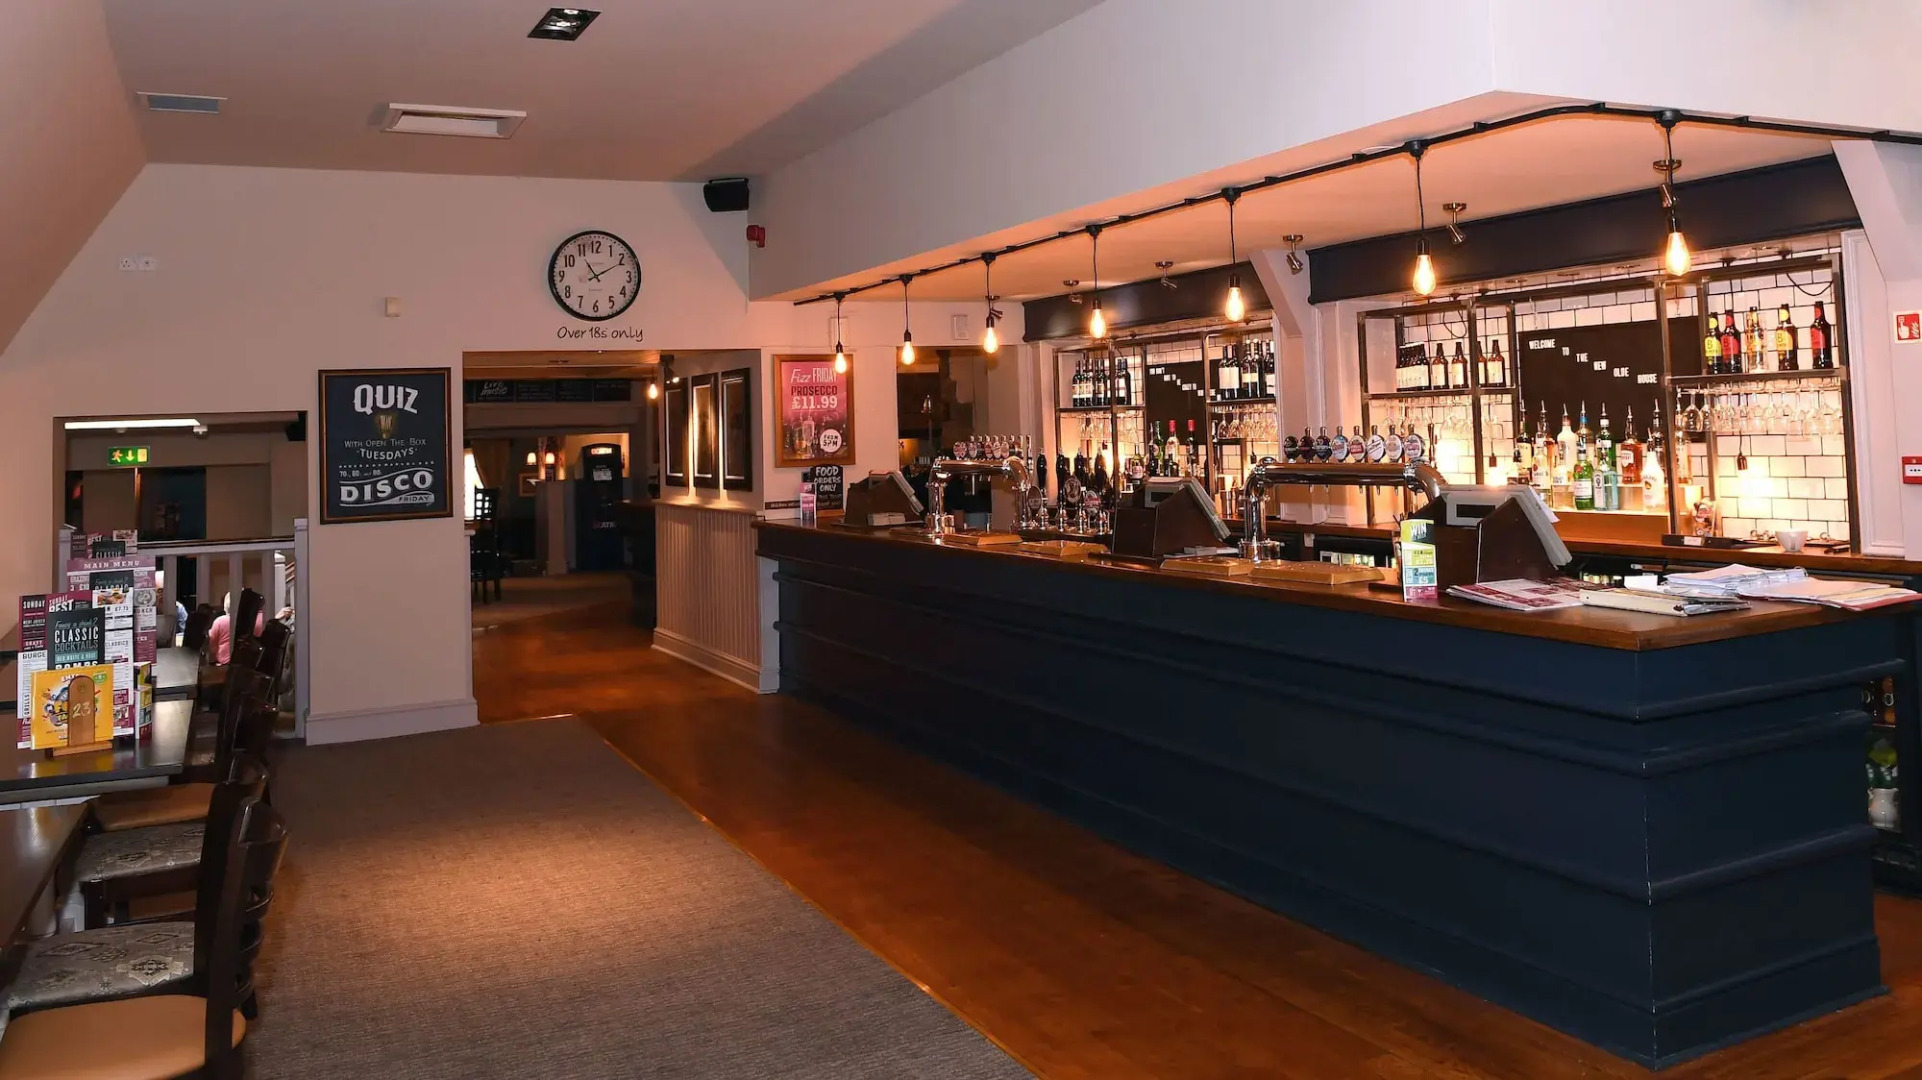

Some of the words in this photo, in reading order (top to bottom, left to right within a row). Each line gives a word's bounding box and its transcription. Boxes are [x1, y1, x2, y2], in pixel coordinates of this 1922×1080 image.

[578, 244, 586, 257] 11
[591, 240, 601, 254] 12
[564, 254, 575, 268] 10
[618, 253, 625, 265] 2
[559, 270, 565, 282] 9
[626, 270, 632, 283] 3
[565, 285, 571, 298] 8
[620, 286, 626, 298] 4
[578, 296, 583, 308] 7
[593, 300, 599, 313] 6
[609, 296, 615, 309] 5
[557, 326, 587, 339] Over
[611, 326, 643, 342] only
[1529, 339, 1556, 350] WELCOME
[1562, 347, 1569, 356] TO
[1576, 353, 1588, 362] THE
[1594, 360, 1606, 371] NEW
[1613, 367, 1629, 377] OLDE
[791, 369, 811, 383] Fizz
[812, 368, 837, 382] FRIDAY
[791, 386, 837, 396] PROSECCO
[354, 384, 418, 415] QUIZ
[792, 396, 837, 409] £11.99
[360, 447, 414, 460] TUESDAYS
[816, 466, 838, 476] FOOD
[340, 471, 432, 501] DISCO
[1411, 523, 1426, 536] WIN
[23, 600, 45, 609] SUNDAY
[49, 599, 74, 612] BEST
[55, 626, 99, 643] CLASSIC
[55, 640, 98, 652] COCKTAILS
[72, 702, 91, 718] 23
